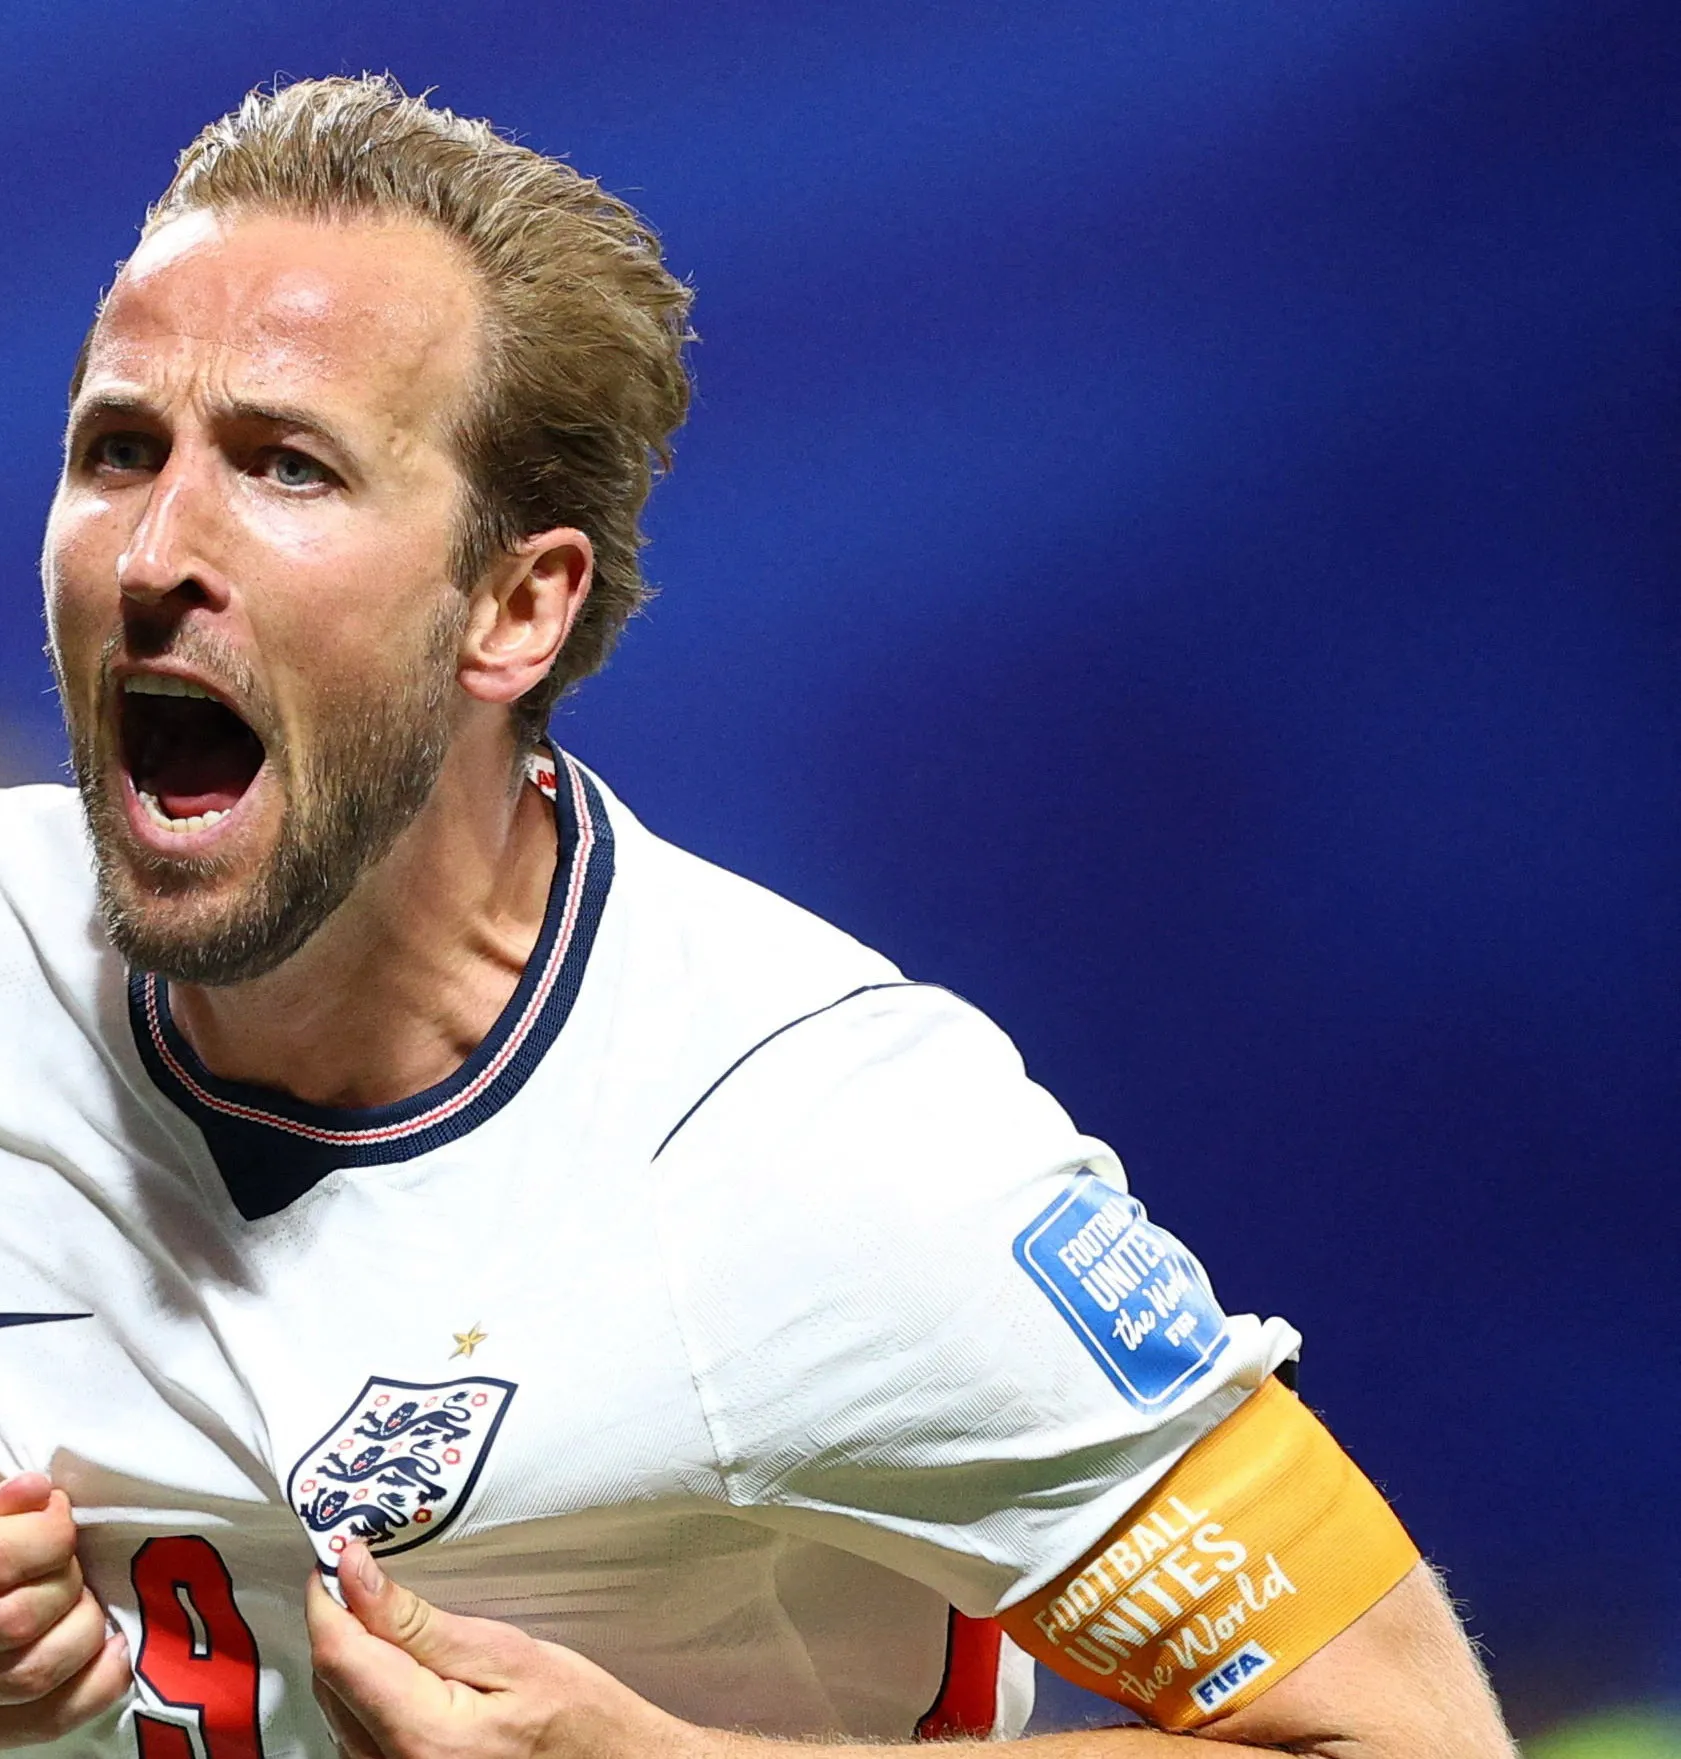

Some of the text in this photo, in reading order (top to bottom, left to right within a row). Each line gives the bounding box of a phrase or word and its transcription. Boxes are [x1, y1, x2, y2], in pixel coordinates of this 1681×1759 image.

[1080, 1219, 1167, 1312] UNITES
[1112, 1309, 1156, 1351] the
[1164, 1310, 1198, 1347] FIFA
[1033, 1496, 1208, 1645] FOOTBALL
[1064, 1522, 1248, 1675] UNITES
[1118, 1553, 1297, 1704] the World
[131, 1534, 265, 1759] 9
[1197, 1652, 1265, 1705] FIFA
